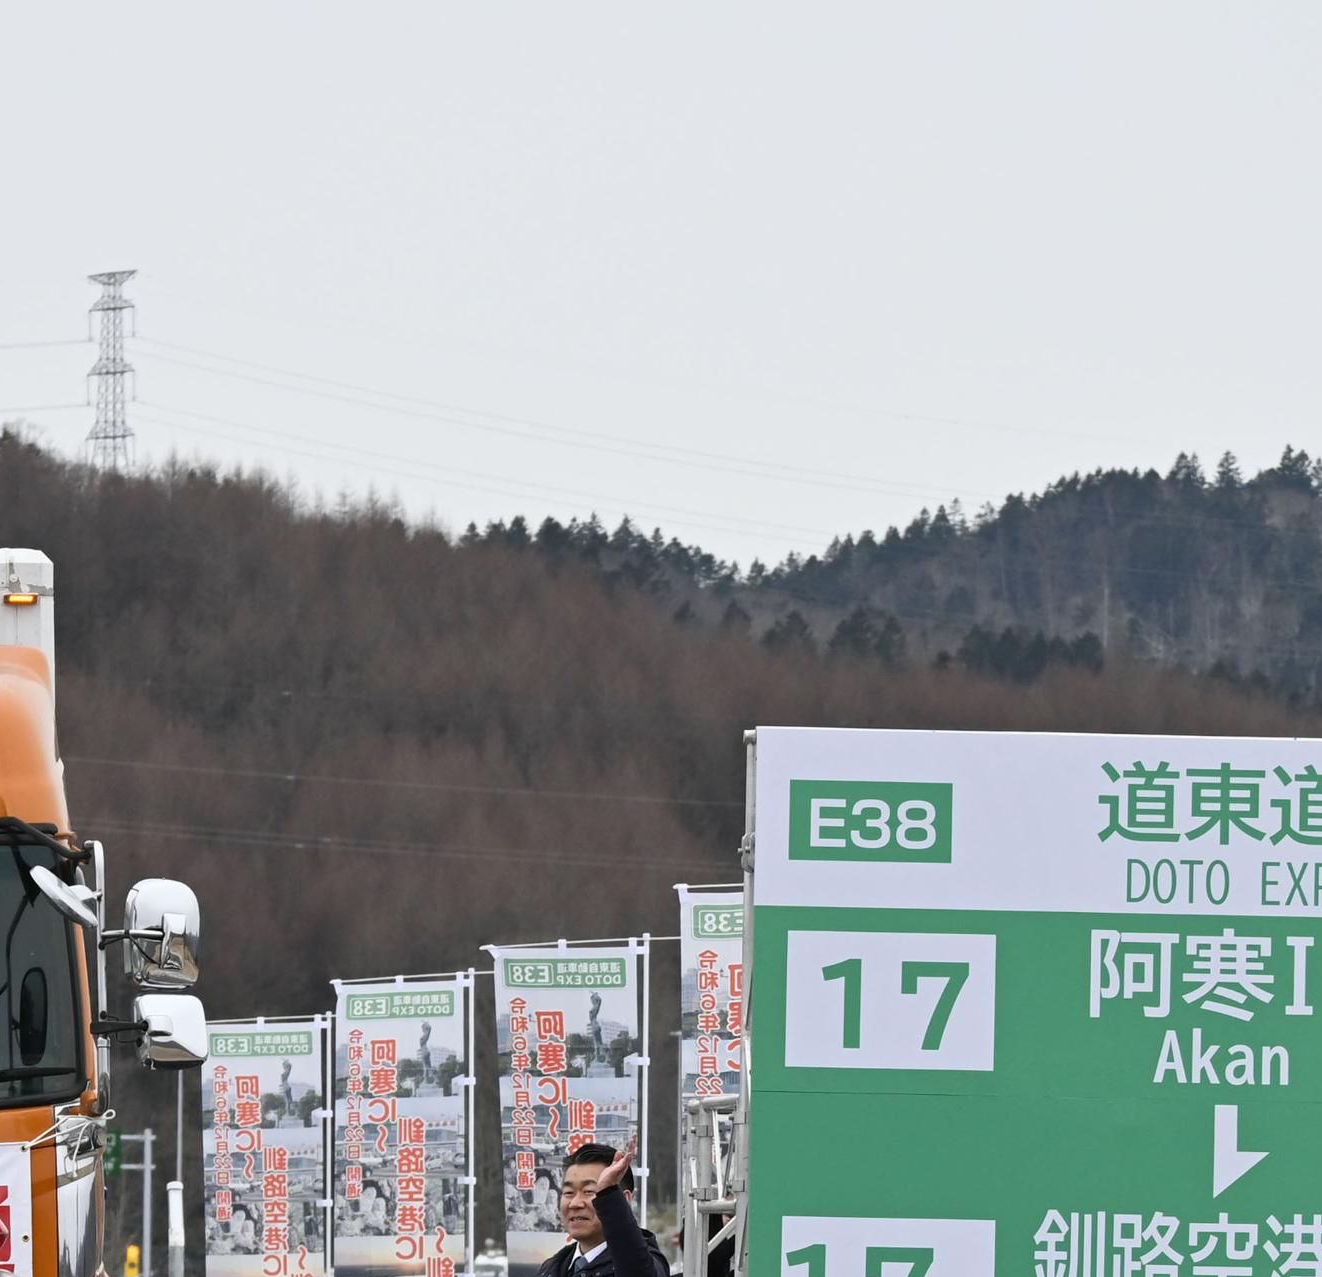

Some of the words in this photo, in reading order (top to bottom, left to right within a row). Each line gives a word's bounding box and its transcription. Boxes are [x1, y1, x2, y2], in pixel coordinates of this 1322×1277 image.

[810, 798, 936, 850] E38
[1126, 858, 1231, 905] DOTO
[822, 958, 972, 1051] 17
[1153, 1029, 1290, 1086] Akan
